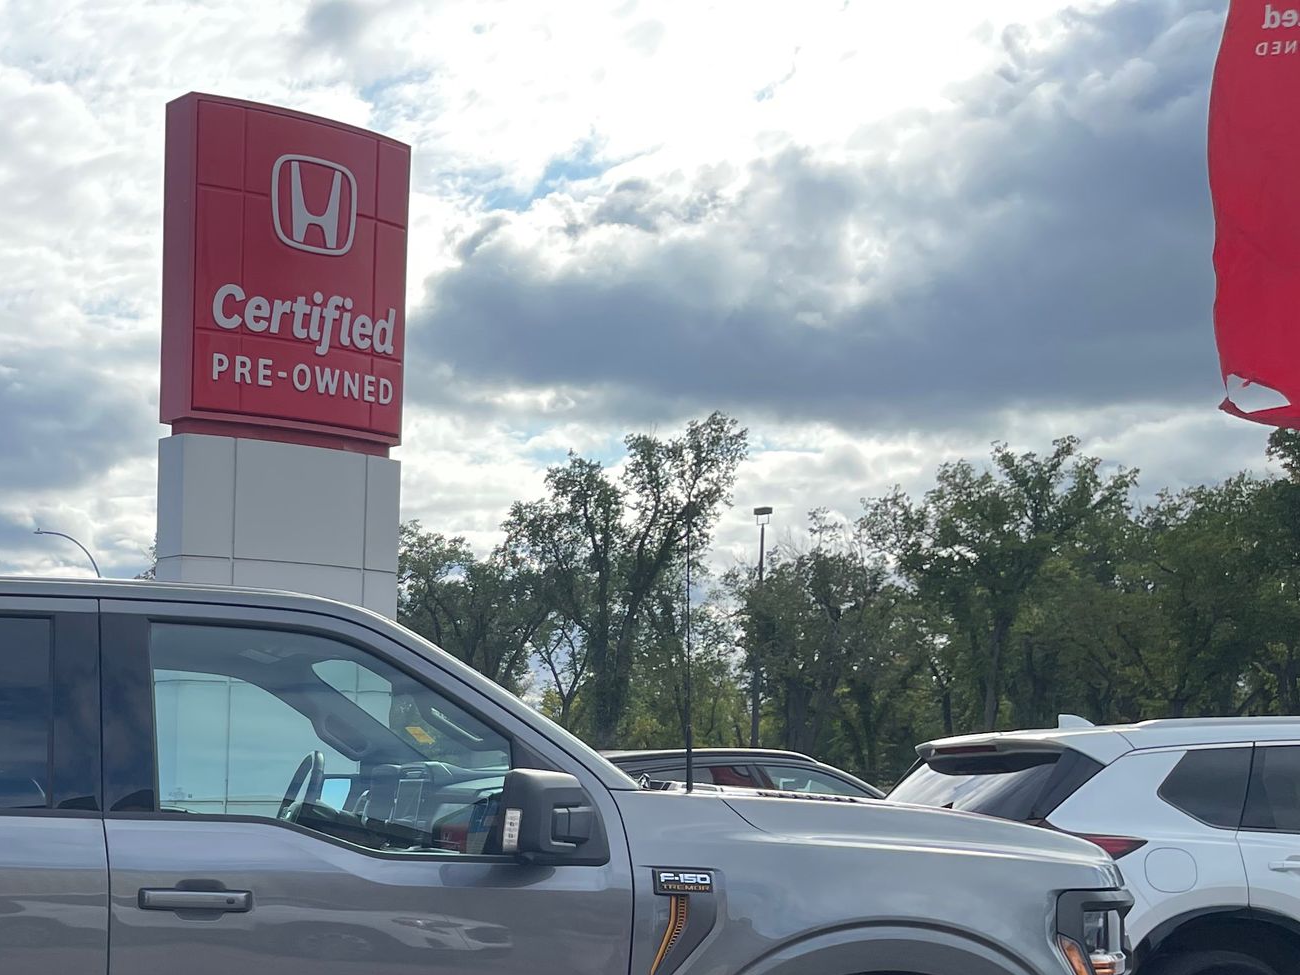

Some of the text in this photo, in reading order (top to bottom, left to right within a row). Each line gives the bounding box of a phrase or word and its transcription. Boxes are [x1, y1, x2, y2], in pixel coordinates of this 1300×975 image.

[212, 283, 396, 356] Certified
[212, 352, 394, 405] PRE-OWNED
[660, 872, 711, 884] F-150
